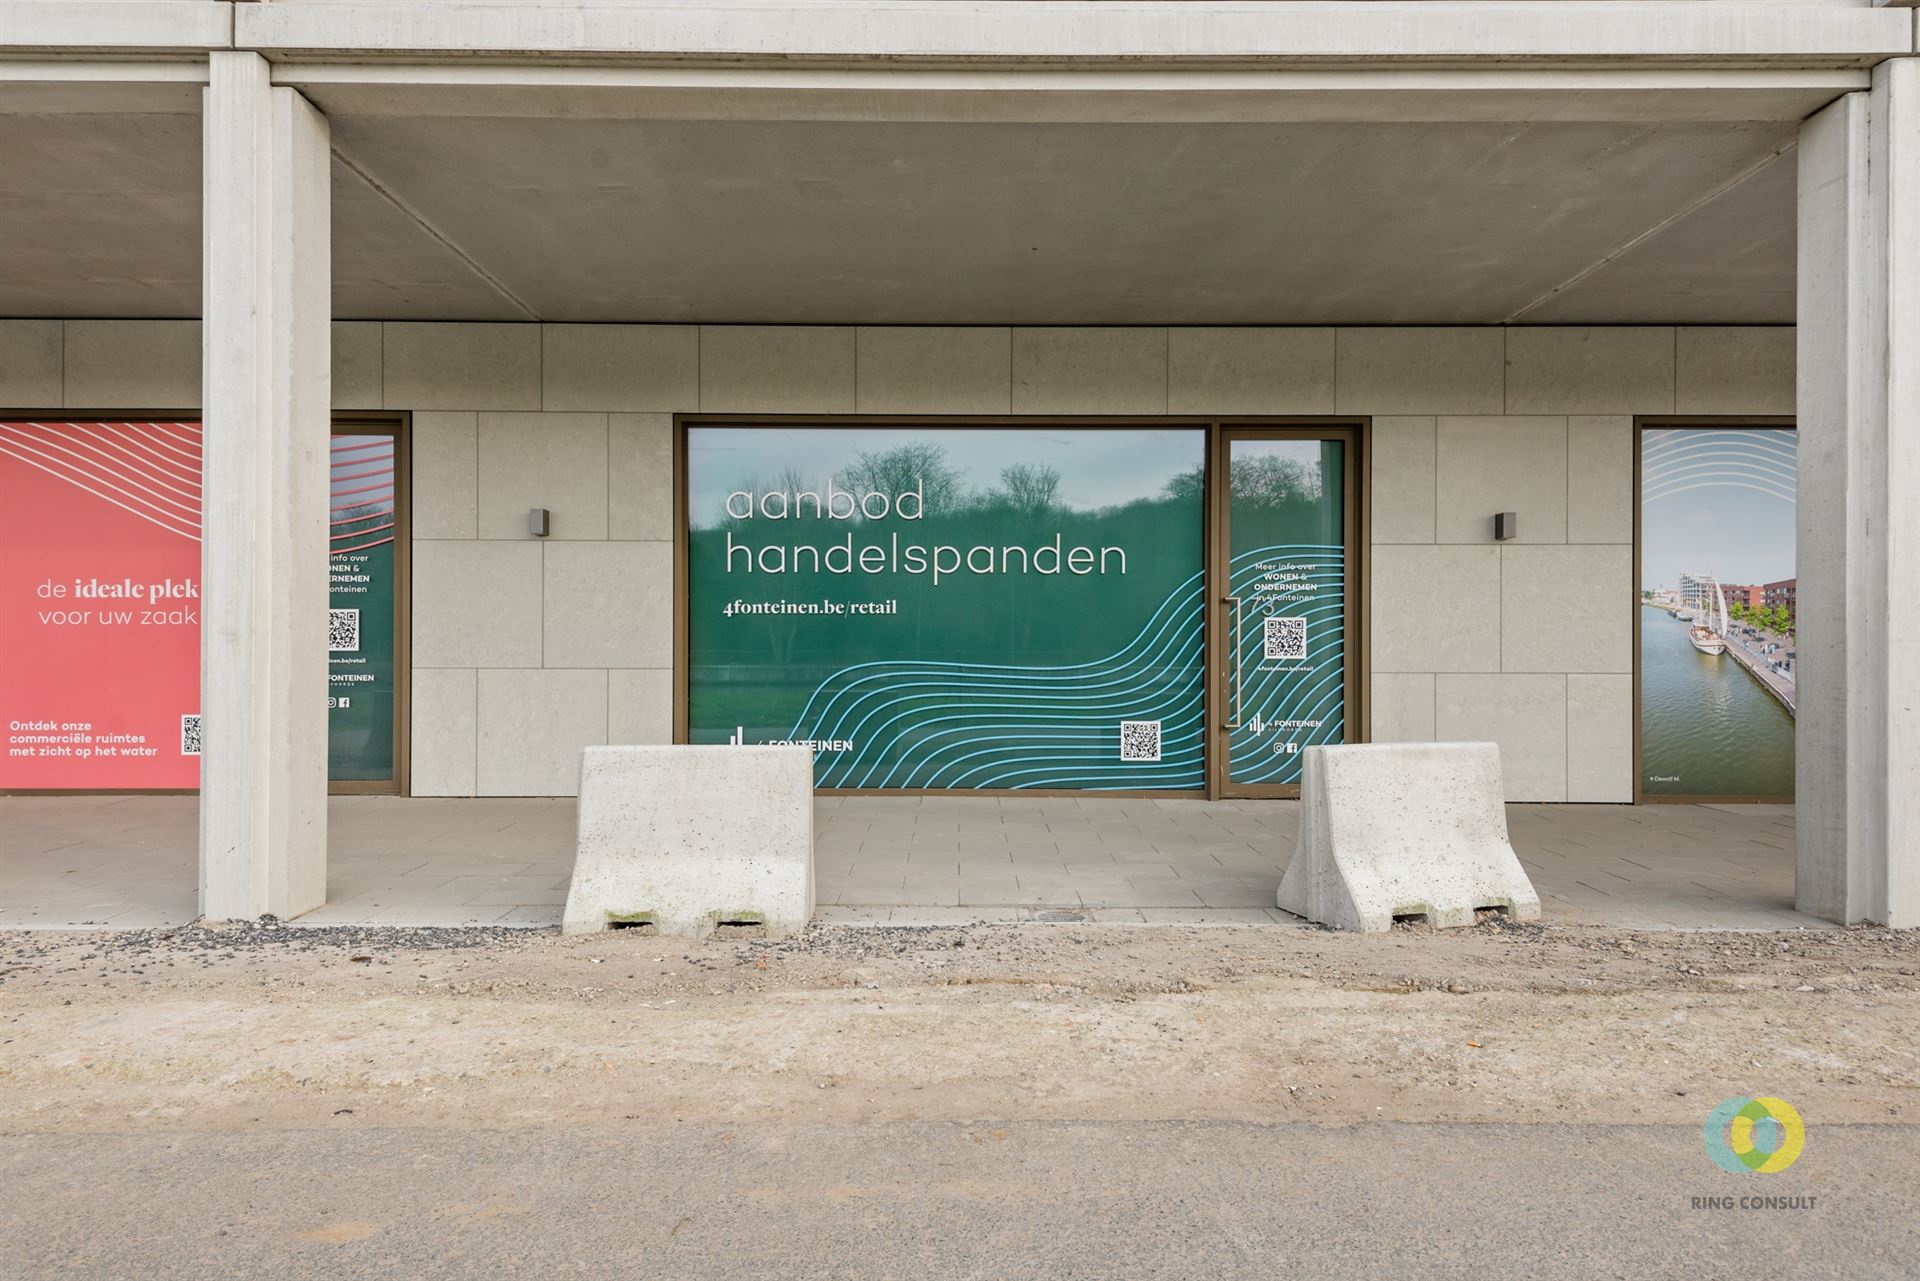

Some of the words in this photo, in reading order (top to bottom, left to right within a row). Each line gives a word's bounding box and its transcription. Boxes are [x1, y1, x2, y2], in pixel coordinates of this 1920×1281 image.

[726, 479, 924, 520] aanbod
[726, 532, 1127, 586] handelspanden
[329, 564, 351, 572] NEN
[353, 564, 360, 572] &
[1255, 562, 1276, 570] Meer
[1278, 562, 1296, 570] info
[37, 579, 67, 598] de
[74, 578, 145, 599] ideale
[149, 578, 200, 605] plek
[329, 585, 368, 593] onteinen
[1253, 583, 1317, 591] ONDERNEMEN
[722, 599, 898, 618] 4fonteinen.be/retail
[38, 610, 92, 625] voor
[99, 610, 133, 625] uw
[140, 605, 198, 625] zaak
[10, 720, 58, 732] Ontdek
[61, 723, 92, 732] onze
[1274, 720, 1322, 728] FONTEINEN
[10, 732, 92, 744] commerciële
[95, 733, 146, 744] ruimtes
[10, 747, 35, 757] met
[39, 746, 71, 757] zicht
[75, 748, 92, 759] op
[95, 746, 117, 757] het
[120, 747, 158, 757] water
